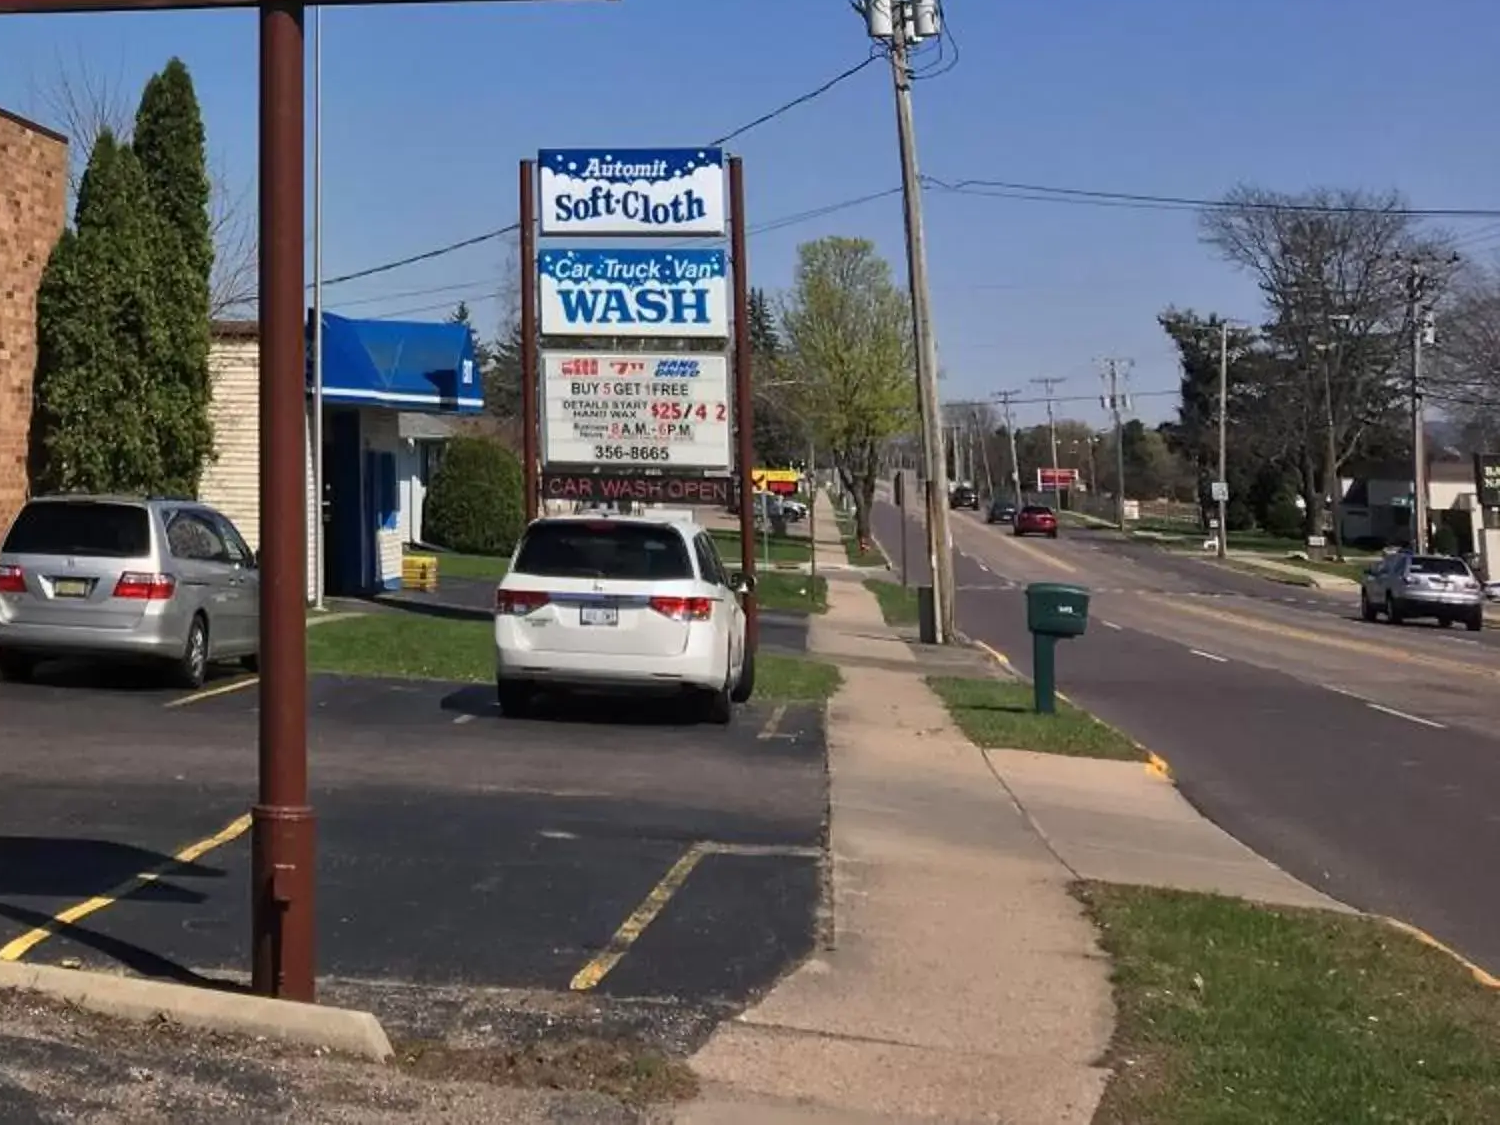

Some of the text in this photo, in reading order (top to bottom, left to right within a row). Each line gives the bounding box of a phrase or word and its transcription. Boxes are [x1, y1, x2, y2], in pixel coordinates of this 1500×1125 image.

[555, 258, 712, 279] Car Truck Van
[556, 288, 711, 324] WASH
[571, 383, 600, 396] BUY
[613, 383, 641, 396] GET
[652, 383, 689, 396] FREE
[563, 400, 609, 410] DETAILS
[609, 410, 637, 419] WAX
[595, 445, 670, 460] 356-8665
[549, 478, 728, 501] CAR WASH OPEN
